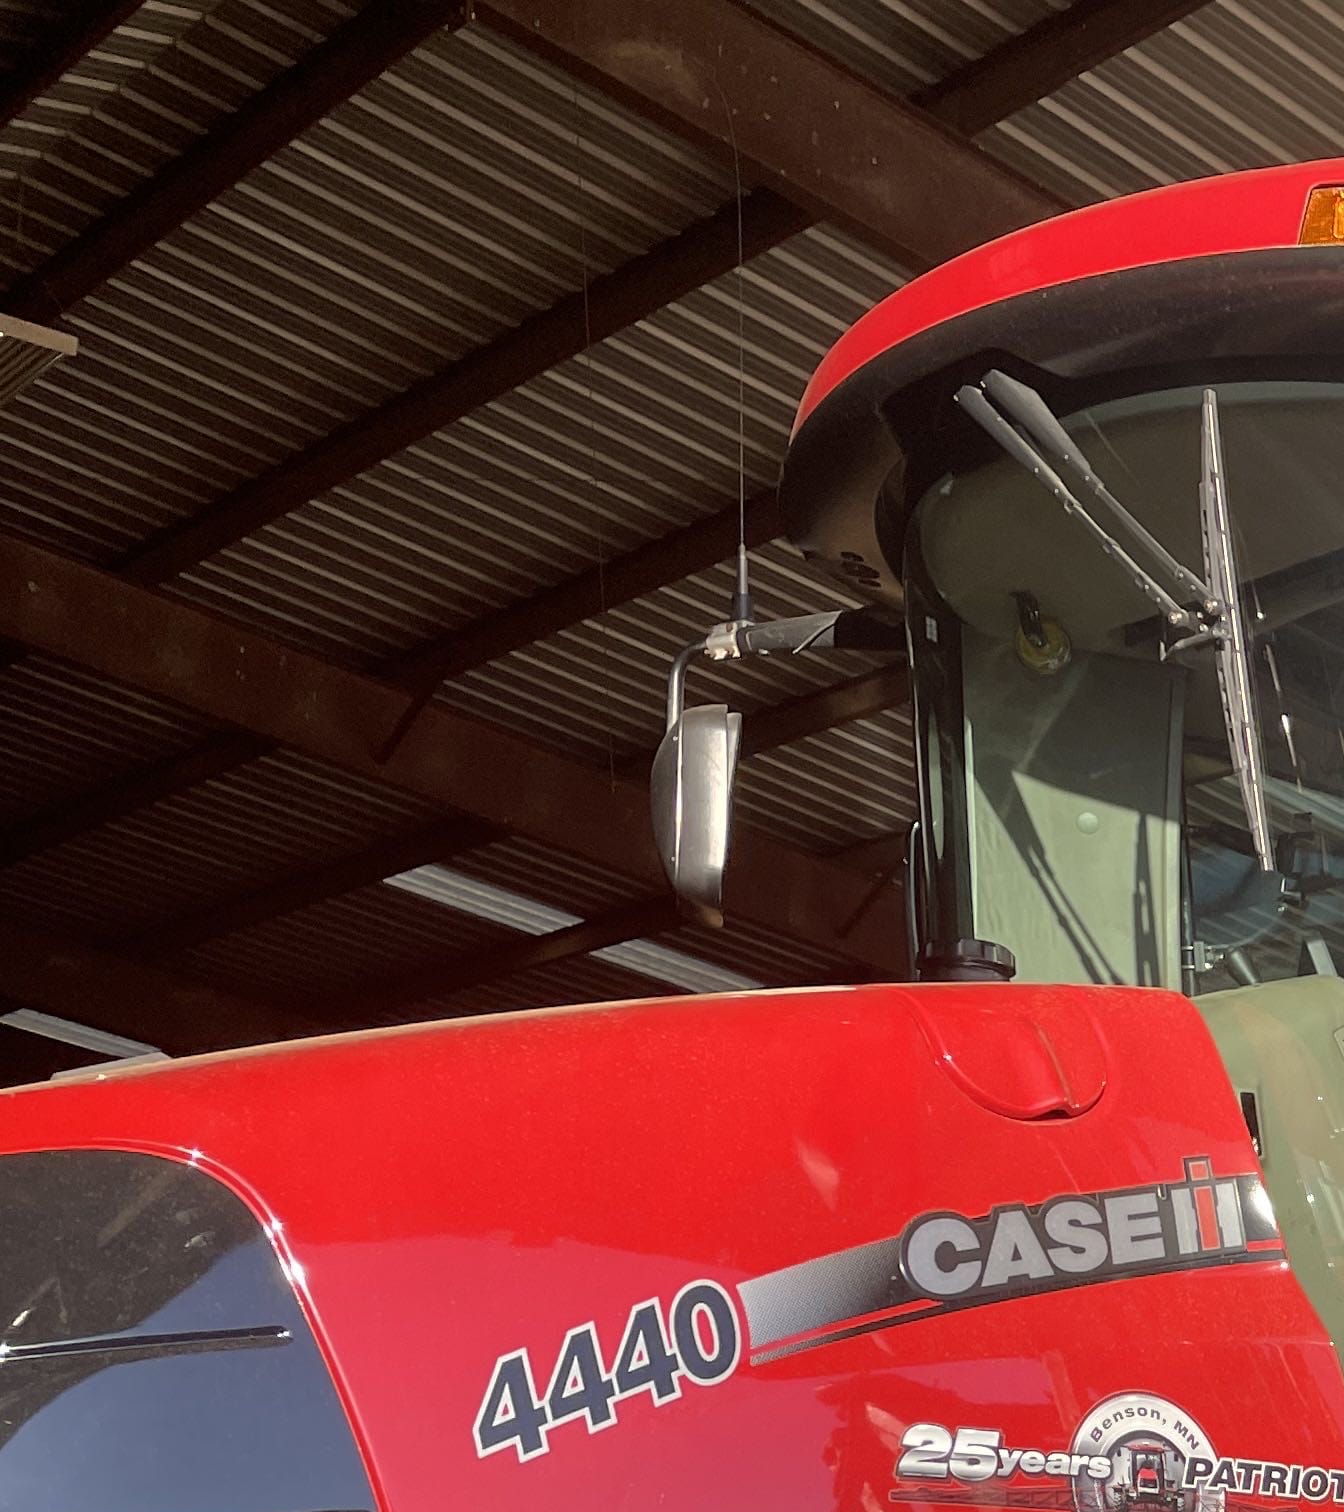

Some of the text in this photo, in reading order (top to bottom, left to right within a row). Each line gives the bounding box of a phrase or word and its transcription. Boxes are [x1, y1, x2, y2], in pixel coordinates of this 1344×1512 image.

[473, 1279, 741, 1463] 4440
[1090, 1406, 1200, 1451] Benson, MN
